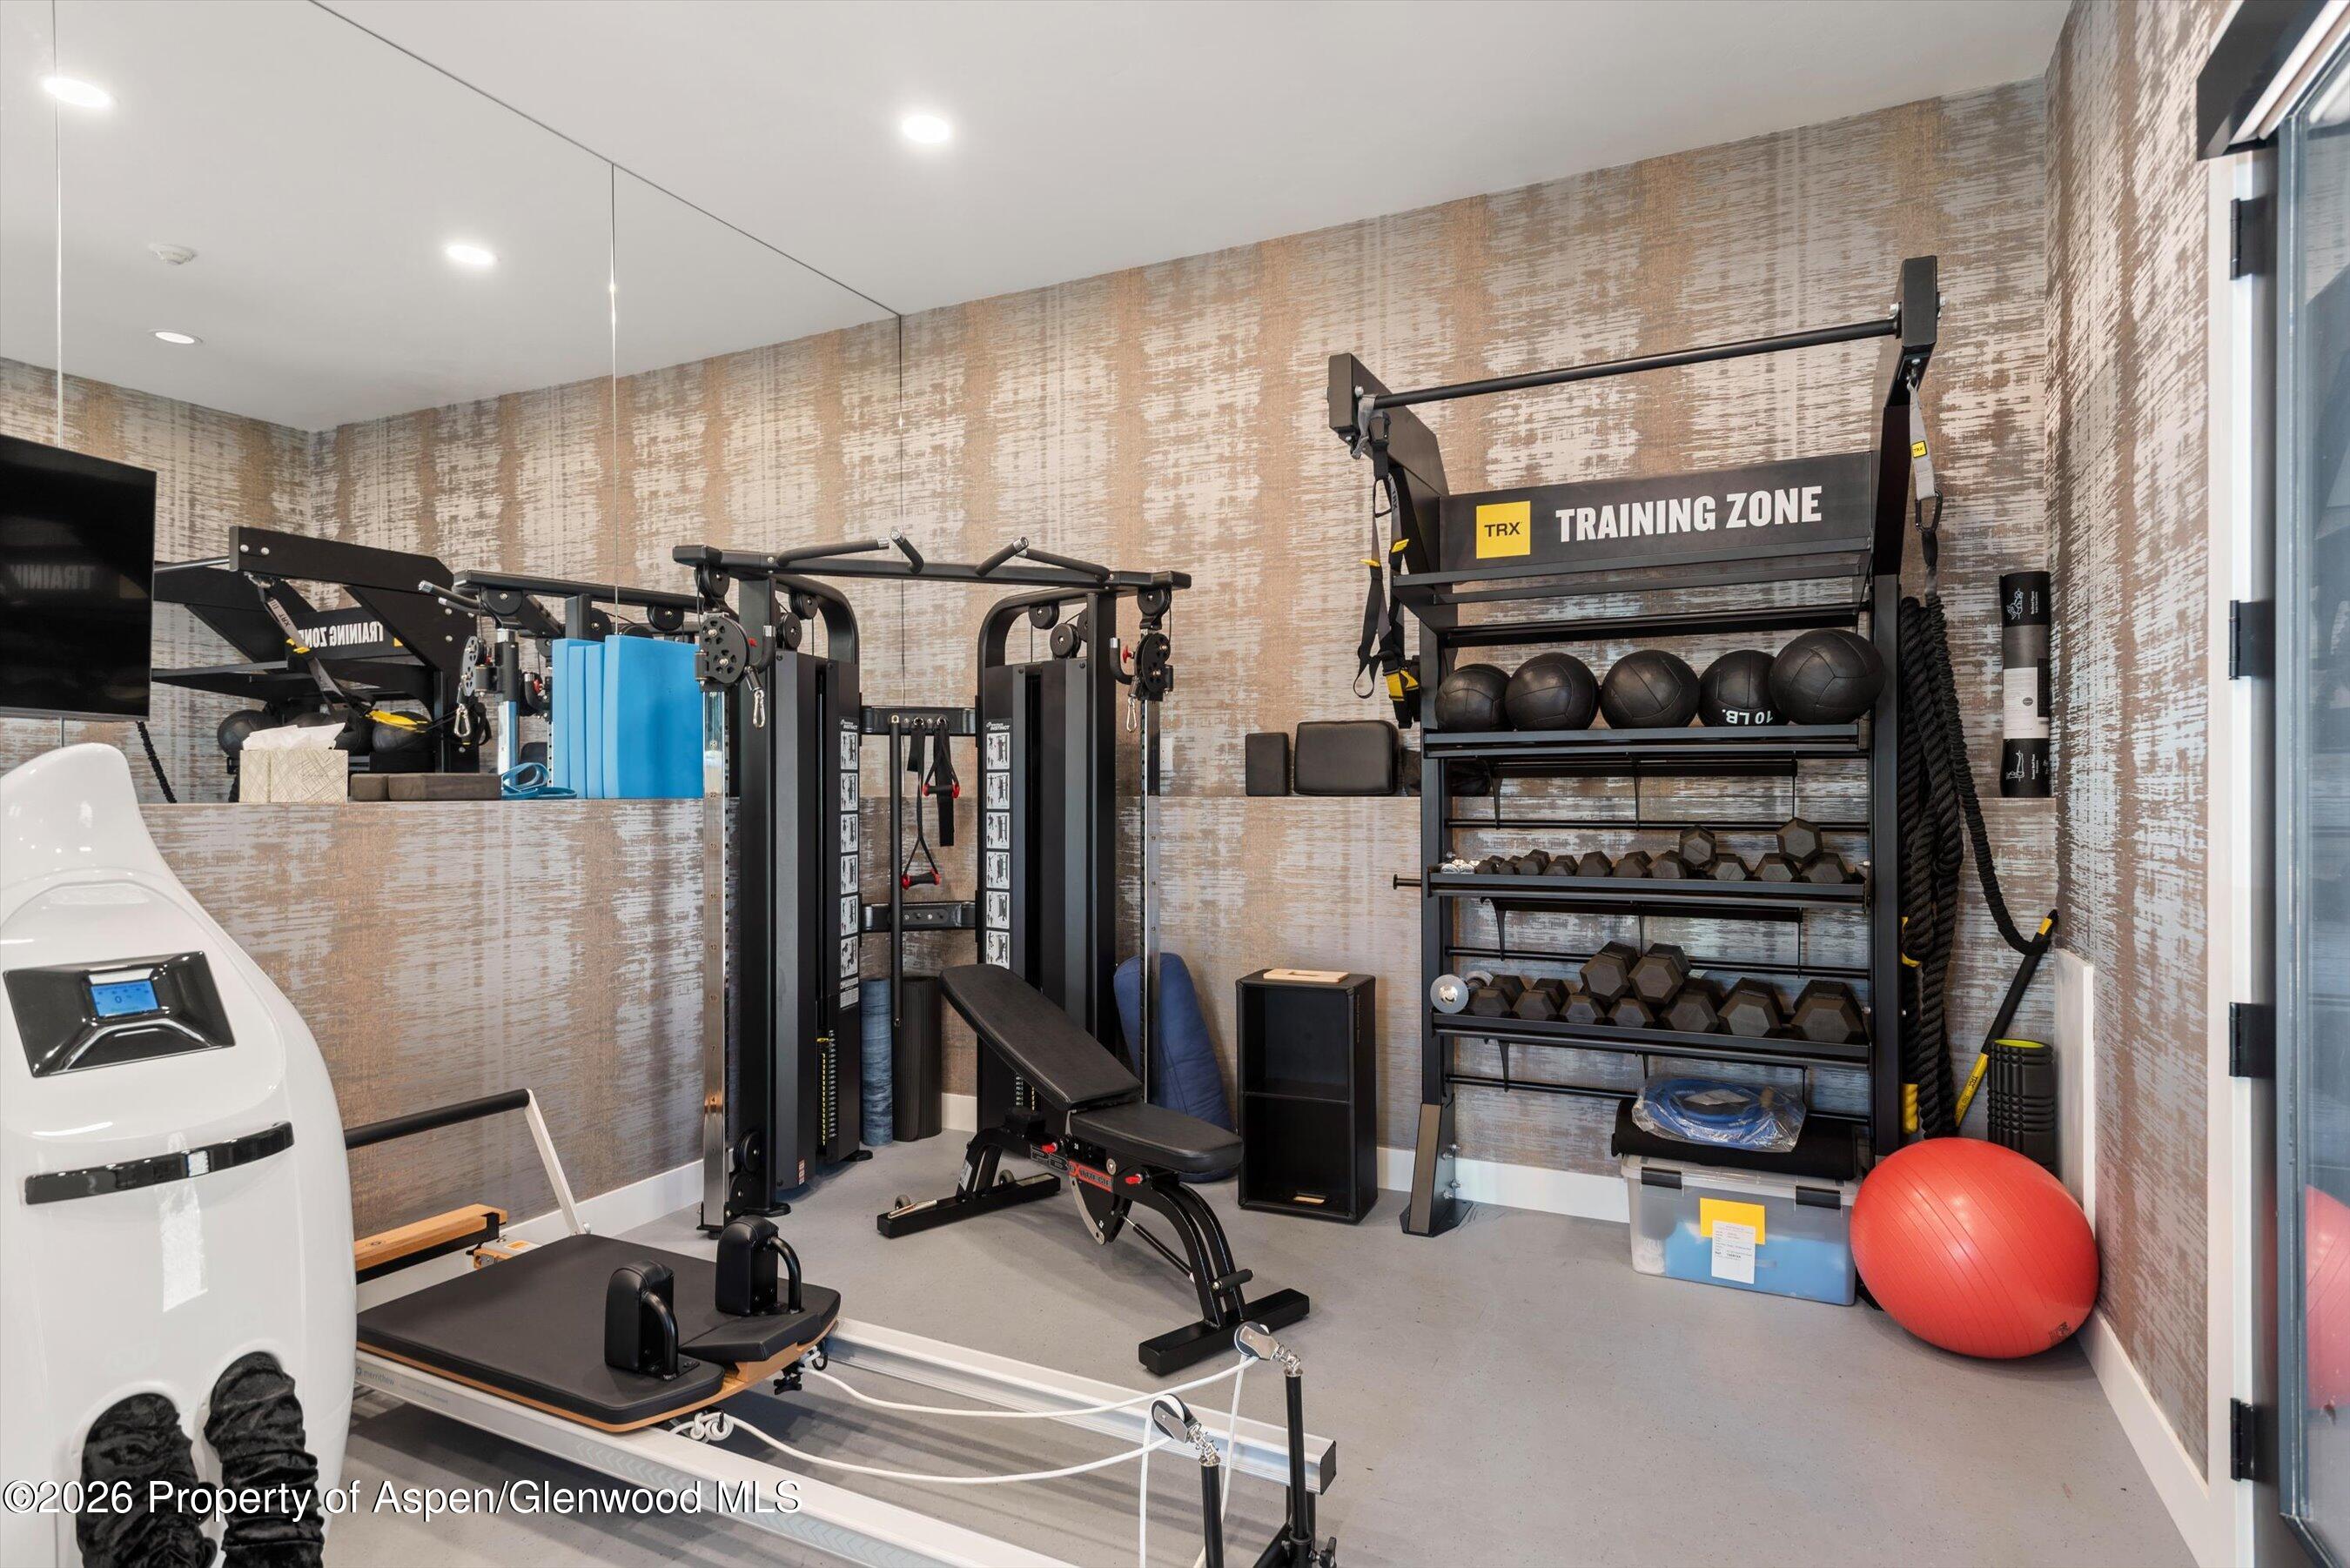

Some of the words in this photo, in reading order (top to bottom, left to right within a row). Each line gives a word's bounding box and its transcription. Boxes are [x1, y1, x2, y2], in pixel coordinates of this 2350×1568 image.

[1555, 495, 1716, 543] TRAINING
[1725, 486, 1823, 529] ZONE
[1484, 521, 1521, 538] TRX
[1722, 708, 1750, 726] LB.
[1754, 710, 1774, 725] 10
